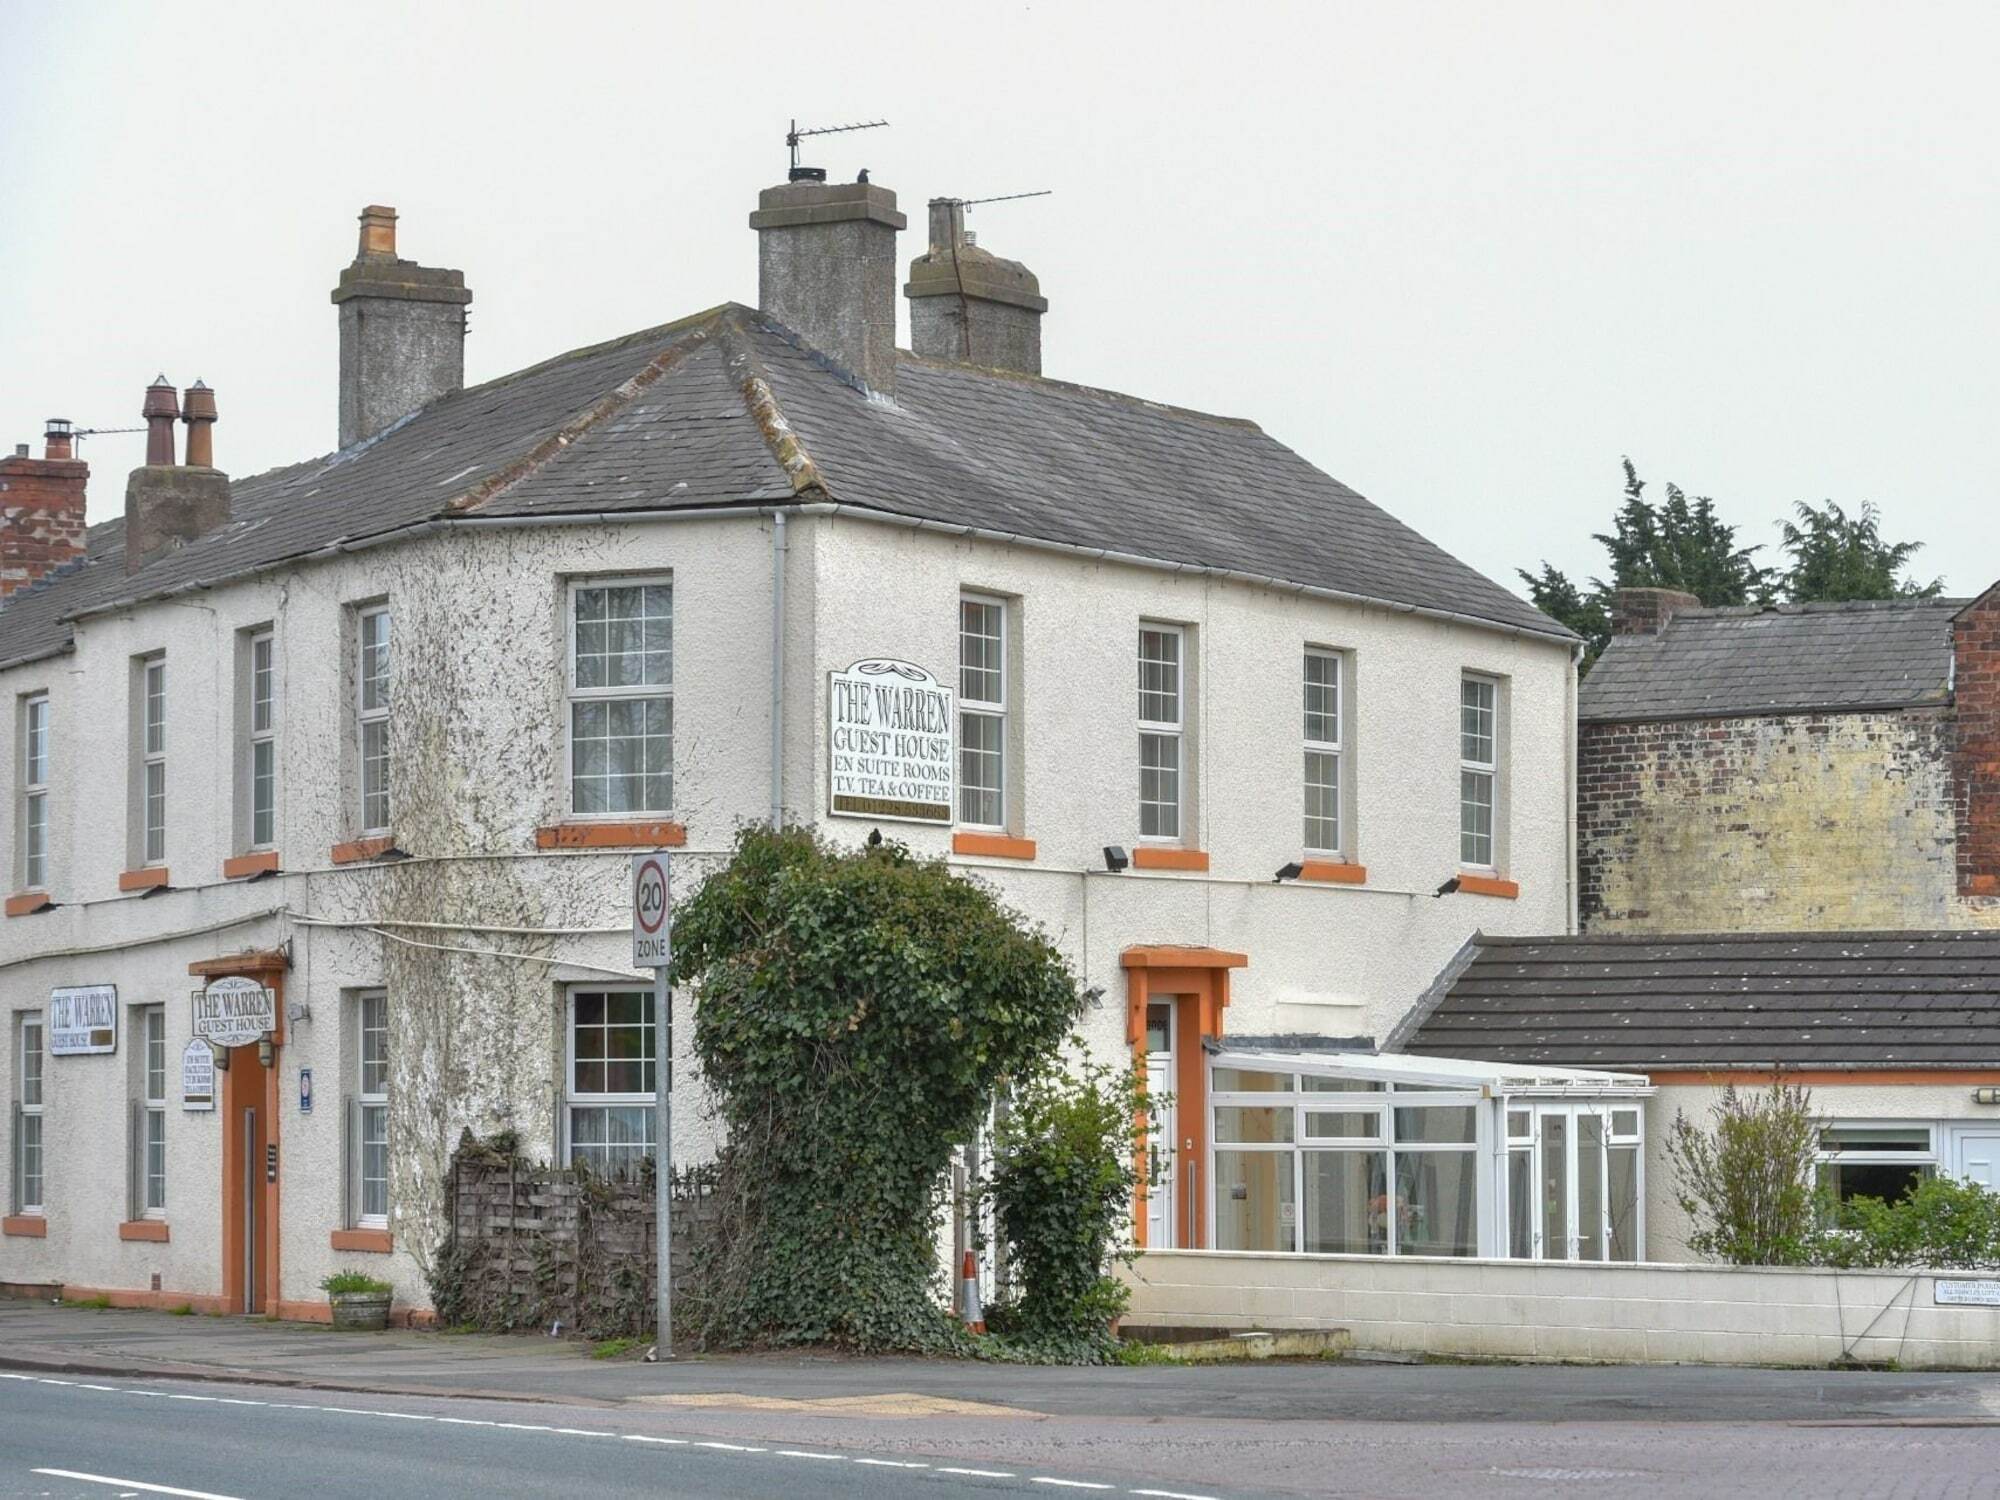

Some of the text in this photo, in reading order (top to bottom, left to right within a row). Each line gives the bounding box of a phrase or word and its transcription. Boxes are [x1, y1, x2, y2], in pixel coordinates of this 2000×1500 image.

[833, 679, 950, 734] THE WARREN
[833, 726, 950, 763] GUEST HOUSE
[834, 755, 950, 782] EN SUITE ROOMS
[641, 882, 662, 912] 20
[637, 938, 666, 958] ZONE
[51, 992, 113, 1029] THE WARREN
[194, 990, 273, 1020] THE WARREN
[198, 1016, 271, 1034] GUEST HOUSE
